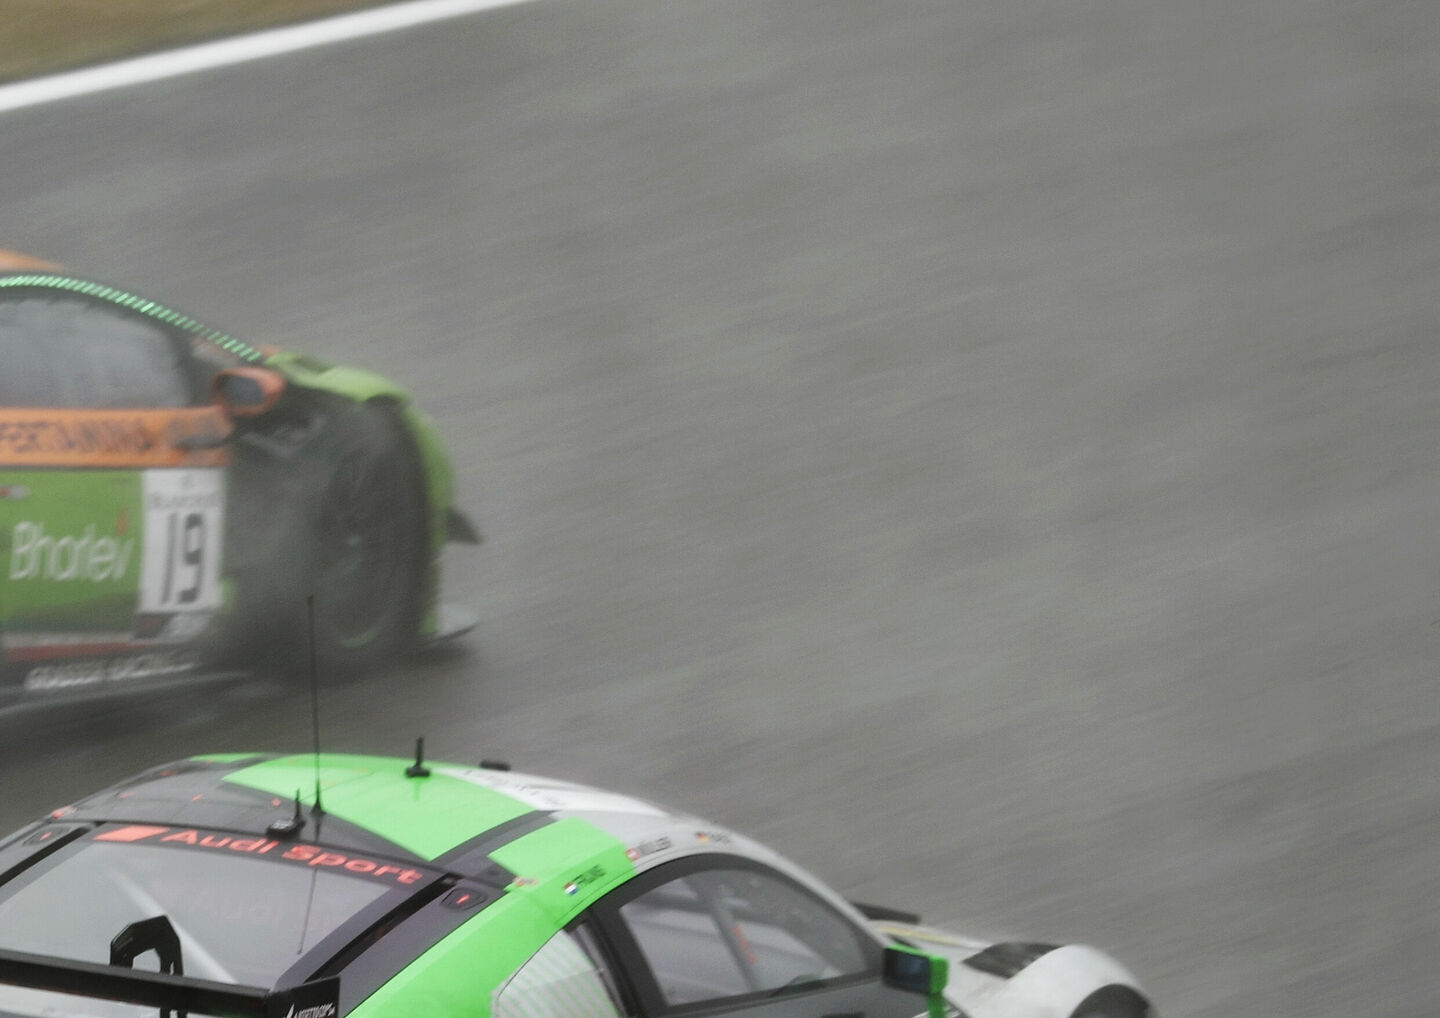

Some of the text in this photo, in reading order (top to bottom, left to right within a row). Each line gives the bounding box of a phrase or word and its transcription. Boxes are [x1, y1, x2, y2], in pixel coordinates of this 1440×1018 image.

[162, 511, 206, 605] 19
[160, 829, 424, 885] Audi Sport
